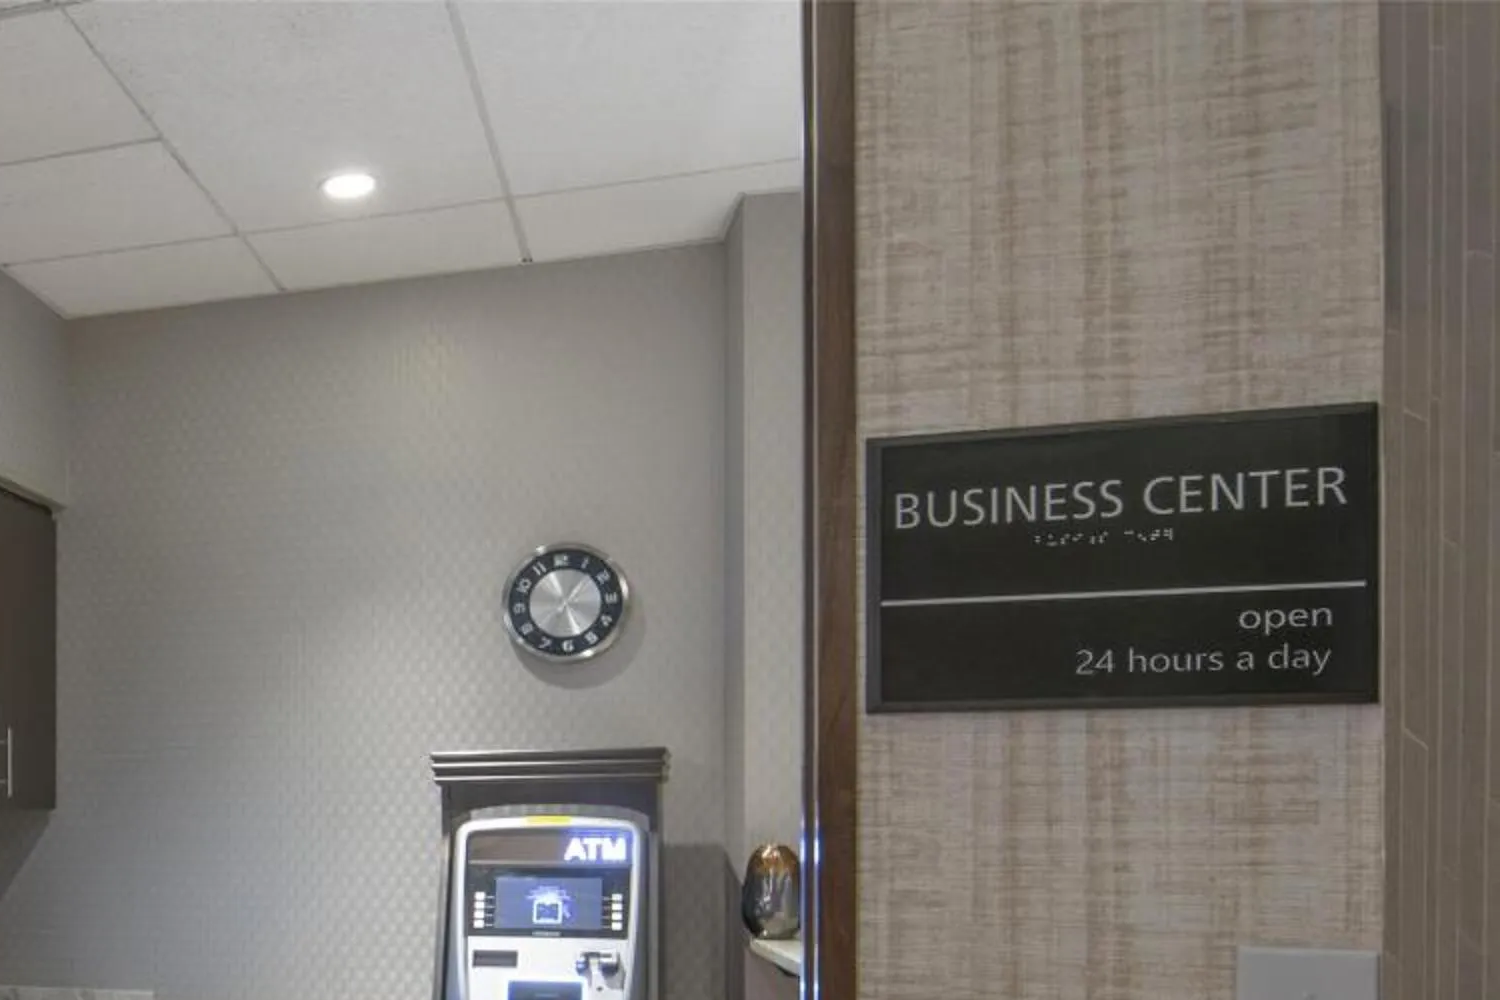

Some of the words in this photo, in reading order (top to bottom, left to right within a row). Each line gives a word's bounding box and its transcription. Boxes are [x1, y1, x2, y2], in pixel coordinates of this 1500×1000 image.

[894, 478, 1125, 530] BUSINESS
[1142, 466, 1348, 517] CENTER
[1238, 606, 1333, 636] open
[1074, 648, 1115, 676] 24
[1128, 646, 1225, 674] hours
[1236, 650, 1255, 671] a
[1267, 642, 1332, 677] day
[563, 836, 627, 862] ATM
